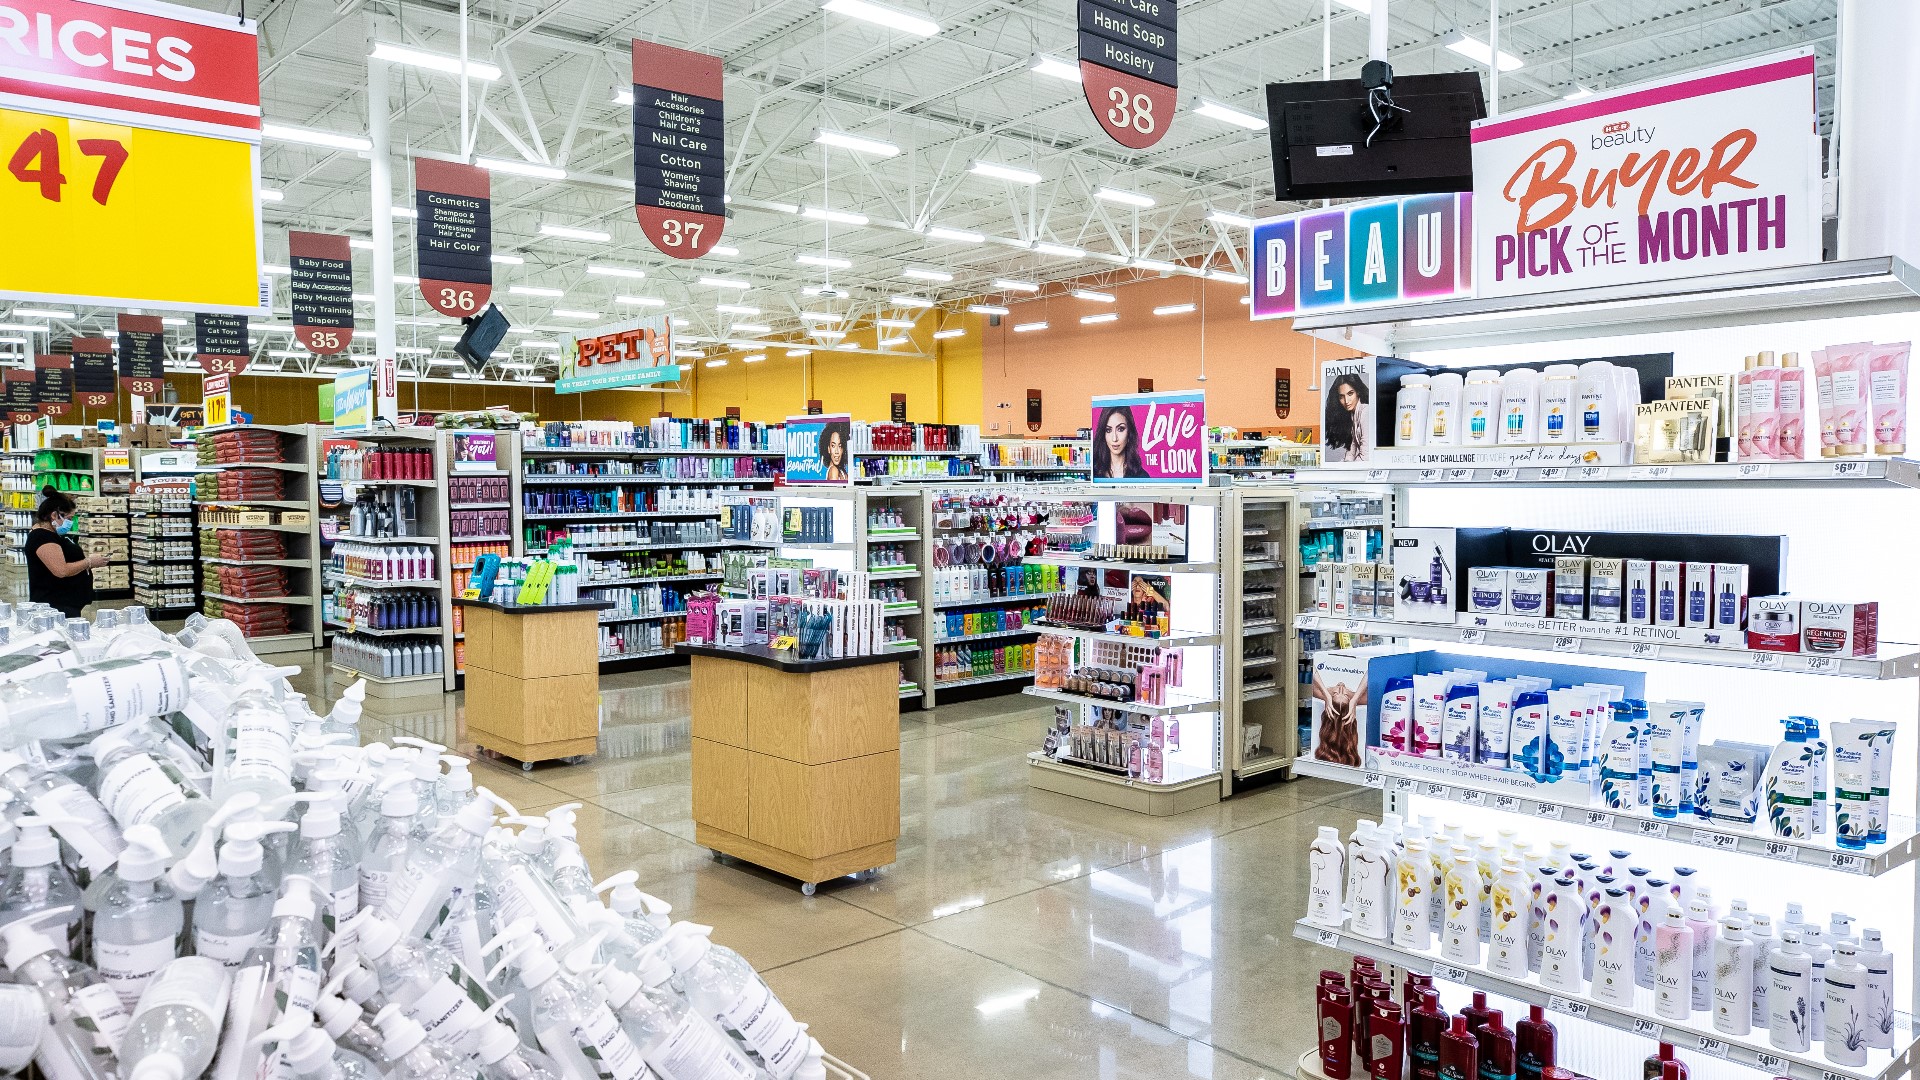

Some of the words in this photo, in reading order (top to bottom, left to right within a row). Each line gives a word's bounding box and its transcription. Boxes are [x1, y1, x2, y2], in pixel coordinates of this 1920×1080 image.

[1094, 10, 1128, 35] Hand
[1133, 24, 1164, 48] Soap
[1106, 44, 1154, 74] Hosiery
[671, 93, 688, 103] Hair
[654, 99, 704, 114] Accessories
[1108, 86, 1154, 134] 38
[658, 111, 701, 126] Children's
[660, 120, 677, 130] Hair
[680, 123, 700, 134] Care
[652, 132, 676, 146] Nail
[680, 137, 707, 150] Care
[1592, 126, 1656, 150] beauty
[660, 154, 701, 169] Cotton
[662, 170, 700, 182] Women's
[664, 178, 698, 192] Shaving
[428, 195, 480, 208] Cosmetics
[662, 190, 700, 202] Women's
[658, 198, 704, 212] Deodorant
[434, 208, 468, 218] Shampoo
[434, 214, 475, 224] Conditioner
[434, 223, 476, 233] Professional
[662, 219, 704, 249] 37
[1496, 226, 1573, 281] PICK
[1583, 222, 1618, 244] OF
[1638, 195, 1786, 264] MONTH
[430, 239, 450, 248] Hair
[454, 242, 480, 252] Color
[1576, 242, 1626, 267] THE
[299, 258, 320, 268] Baby
[294, 270, 314, 278] Baby
[317, 272, 350, 280] Formula
[312, 283, 352, 292] Accessories
[292, 292, 312, 301] Baby
[440, 288, 474, 310] 36
[294, 304, 316, 312] Potty
[320, 306, 352, 315] Training
[308, 316, 340, 324] Diapers
[312, 332, 340, 348] 35
[577, 329, 644, 367] PET
[212, 359, 236, 372] 34
[1326, 364, 1366, 376] PANTENE
[638, 371, 660, 379] FAMILY
[132, 381, 154, 392] 33
[1668, 376, 1724, 390] PANTENE
[88, 395, 106, 406] 32
[1654, 400, 1710, 412] PANTENE
[48, 406, 62, 414] 31
[181, 410, 194, 418] GET
[1142, 401, 1198, 452] Love
[788, 432, 818, 458] MORE
[1145, 454, 1158, 466] THE
[1161, 449, 1197, 473] LOOK
[1419, 455, 1426, 463] 14
[1428, 455, 1439, 463] DAY
[1440, 454, 1476, 463] CHALLENGE
[1510, 448, 1535, 466] great
[1538, 446, 1554, 460] hair
[1558, 446, 1581, 466] days
[1532, 534, 1592, 553] OLAY
[1557, 560, 1582, 568] OLAY
[1593, 560, 1620, 569] OLAY
[1476, 570, 1498, 578] OLAY
[1516, 572, 1538, 580] OLAY
[1760, 600, 1788, 610] OLAY
[1809, 602, 1846, 614] OLAY
[1505, 620, 1535, 628] Hydrates
[1538, 620, 1576, 632] BETTER
[1599, 626, 1610, 634] the
[1615, 626, 1628, 636] #1
[1633, 626, 1680, 640] RETINOL
[1806, 628, 1846, 638] REGENERIST
[1391, 760, 1420, 770] SKINCARE
[1422, 765, 1450, 775] DOESN'T
[1468, 772, 1492, 782] WHERE
[1494, 776, 1510, 784] HAIR
[1511, 780, 1536, 789] BEGINS
[1313, 887, 1330, 896] OLAY
[1356, 896, 1373, 907] OLAY
[1400, 908, 1420, 919] OLAY
[1446, 921, 1467, 932] OLAY
[1494, 933, 1516, 945] OLAY
[1546, 945, 1568, 958] OLAY
[1598, 960, 1622, 971] OLAY
[126, 970, 155, 980] SANIT
[1656, 974, 1678, 986] OLAY
[1774, 981, 1792, 992] IVORY
[1715, 988, 1738, 1000] OLAY
[1826, 992, 1846, 1004] IVORY
[432, 998, 464, 1028] SANITIZER
[742, 1014, 758, 1031] HAND
[1451, 1072, 1464, 1080] Spice
